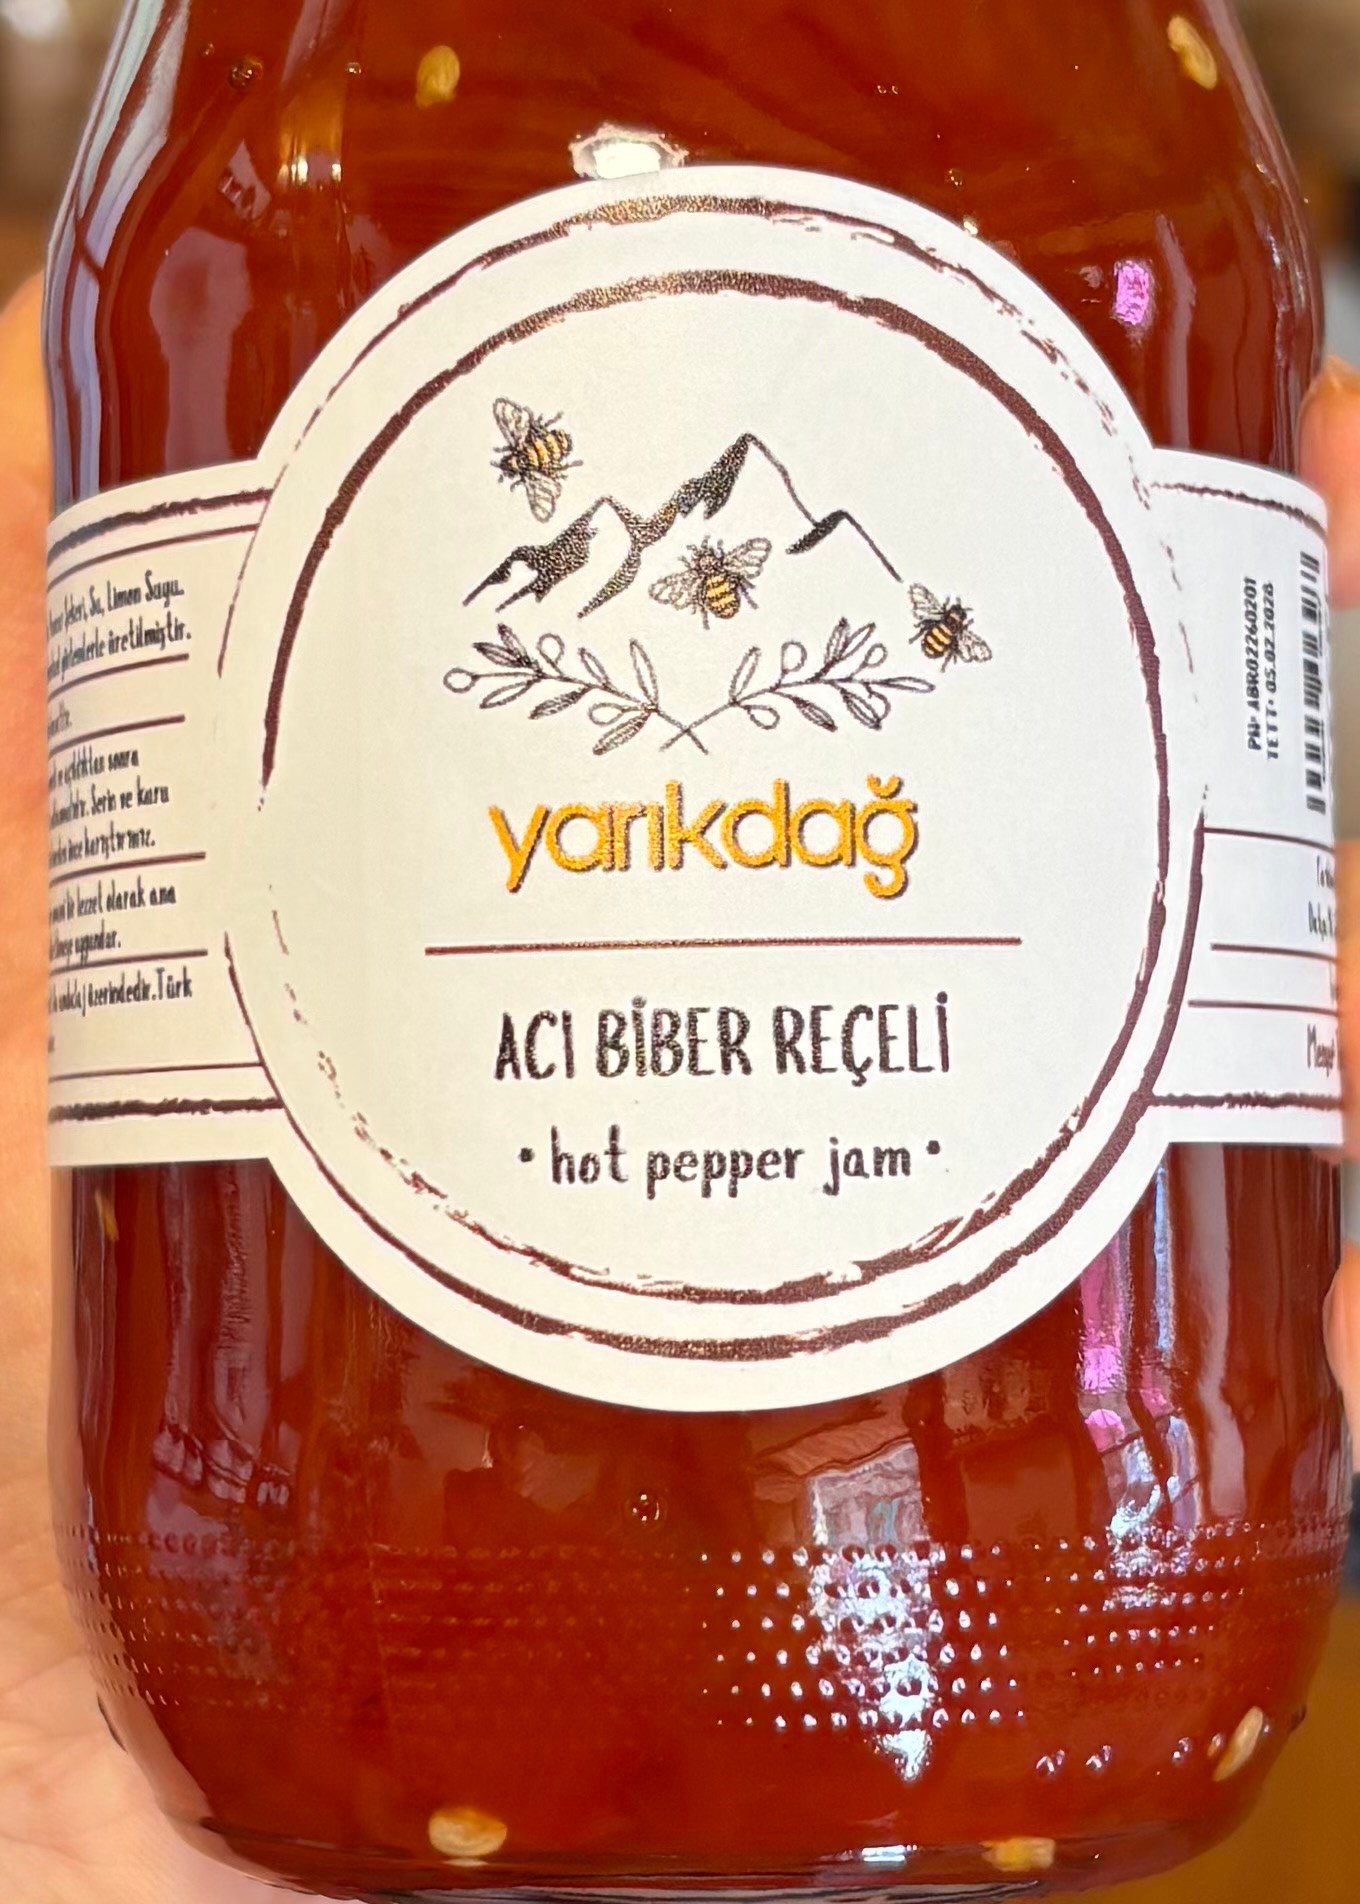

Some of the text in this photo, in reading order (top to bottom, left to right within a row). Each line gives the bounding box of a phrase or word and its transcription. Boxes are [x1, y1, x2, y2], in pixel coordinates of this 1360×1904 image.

[107, 579, 142, 612] Limon
[485, 774, 920, 902] yarıkdağ
[494, 990, 951, 1088] ACI BİBER REÇELİ
[549, 1123, 912, 1201] hot pepper jam
